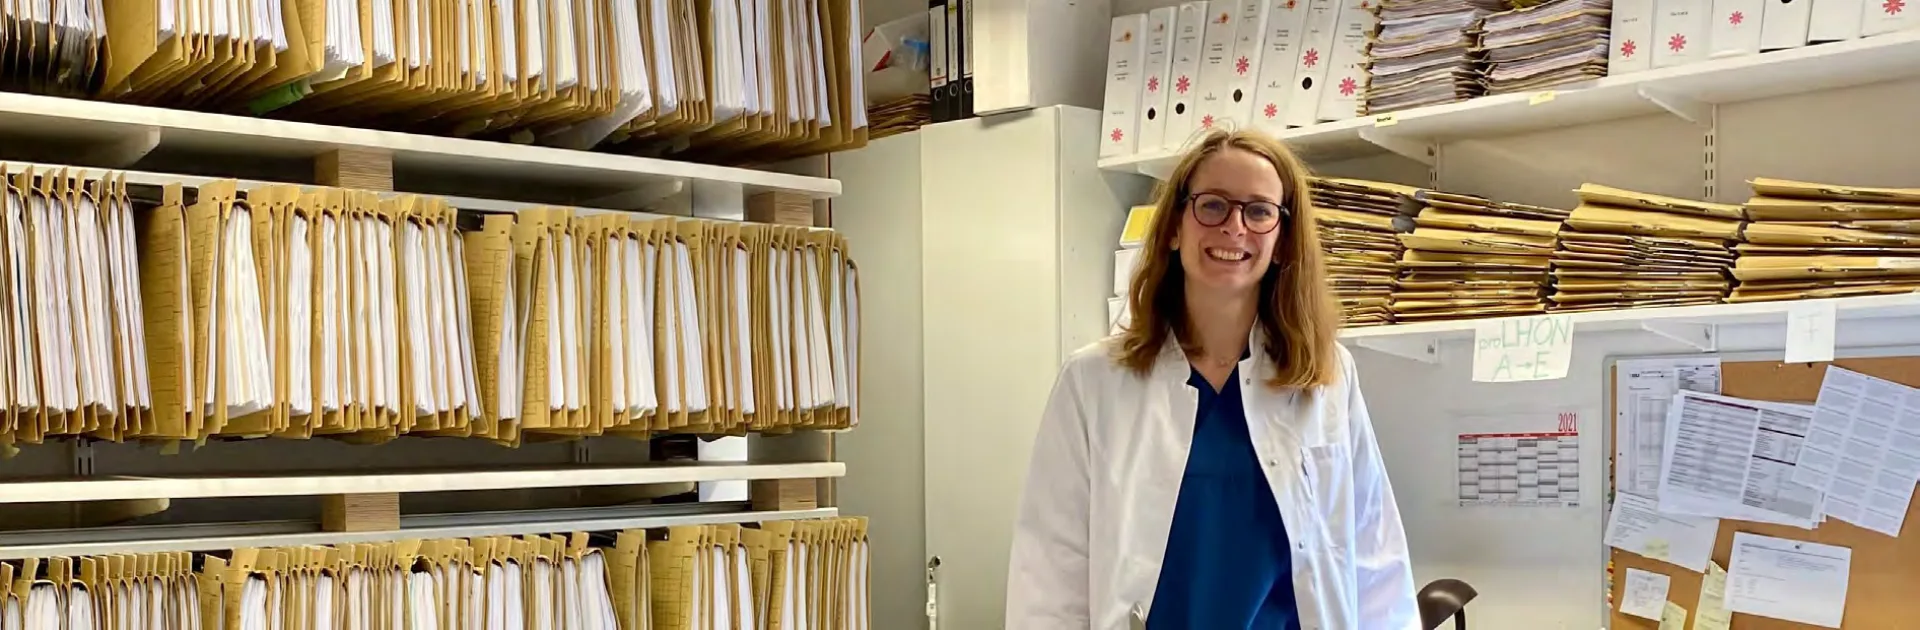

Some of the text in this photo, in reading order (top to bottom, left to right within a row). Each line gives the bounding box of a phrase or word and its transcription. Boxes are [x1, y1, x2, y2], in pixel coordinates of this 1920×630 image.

[1491, 351, 1552, 381] A E
[1558, 412, 1577, 432] 2021
